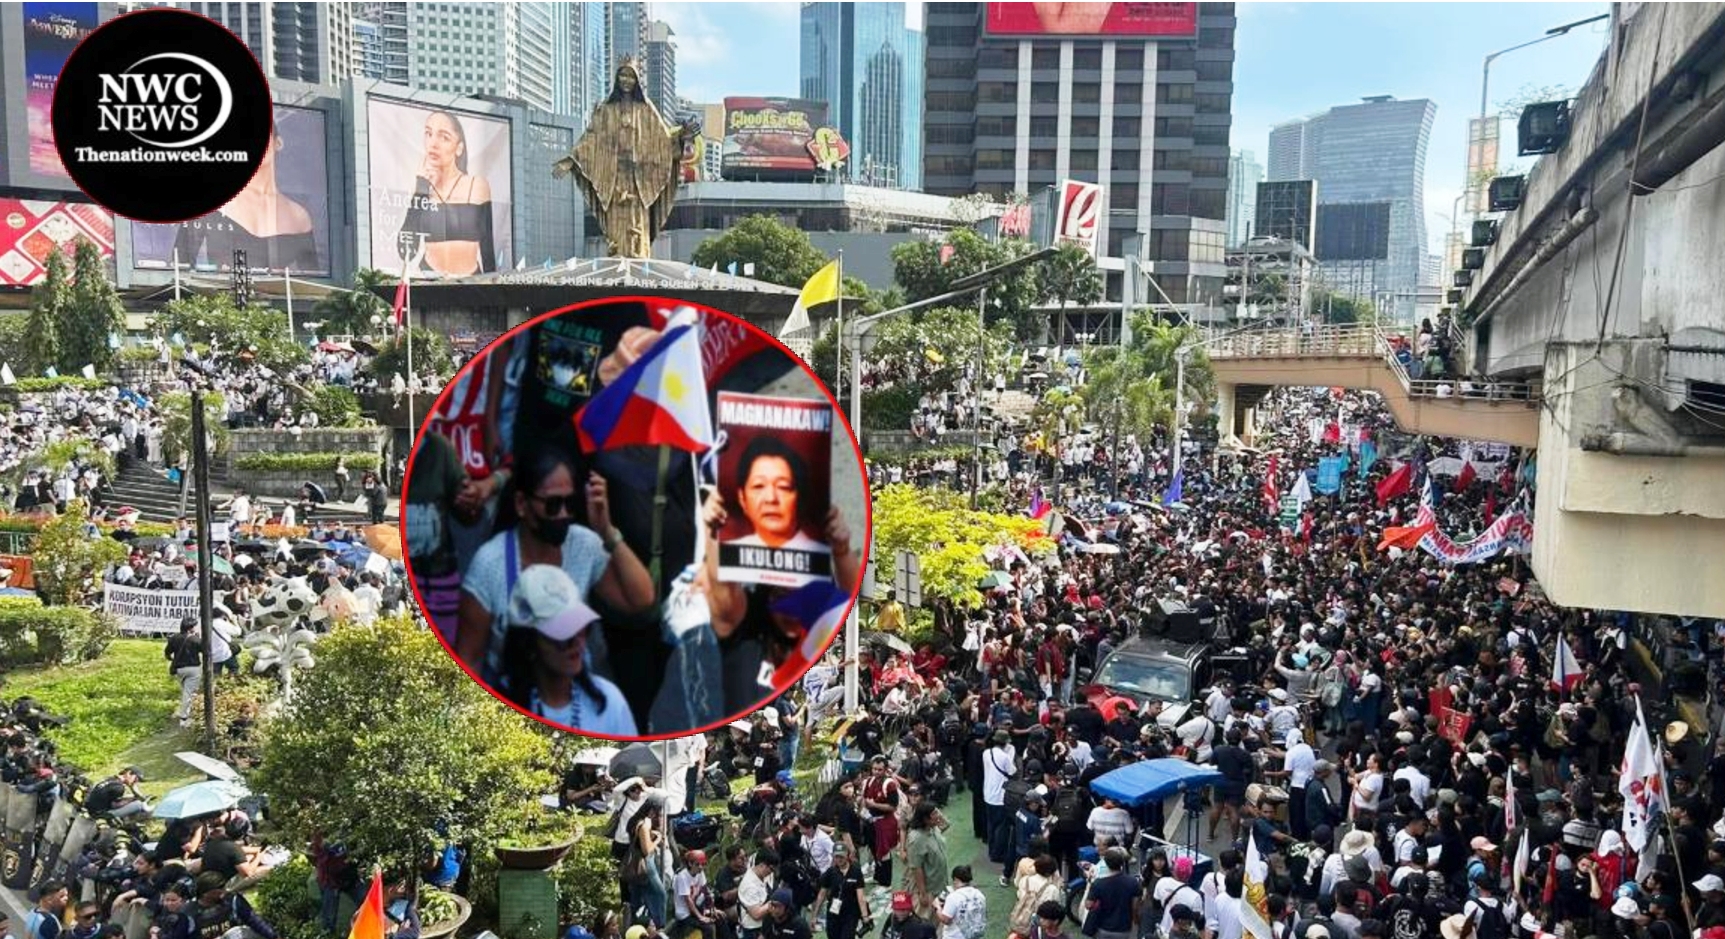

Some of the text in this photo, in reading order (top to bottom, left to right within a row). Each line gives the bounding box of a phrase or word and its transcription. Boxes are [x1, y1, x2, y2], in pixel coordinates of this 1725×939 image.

[379, 186, 438, 212] Andrea
[499, 274, 557, 285] NATIONAL
[561, 276, 602, 287] SHRINE
[660, 279, 699, 290] QUEEN
[720, 401, 829, 431] MAGNANAKAW!
[738, 547, 811, 573] IKULONG!
[109, 590, 162, 608] KORAPSYON
